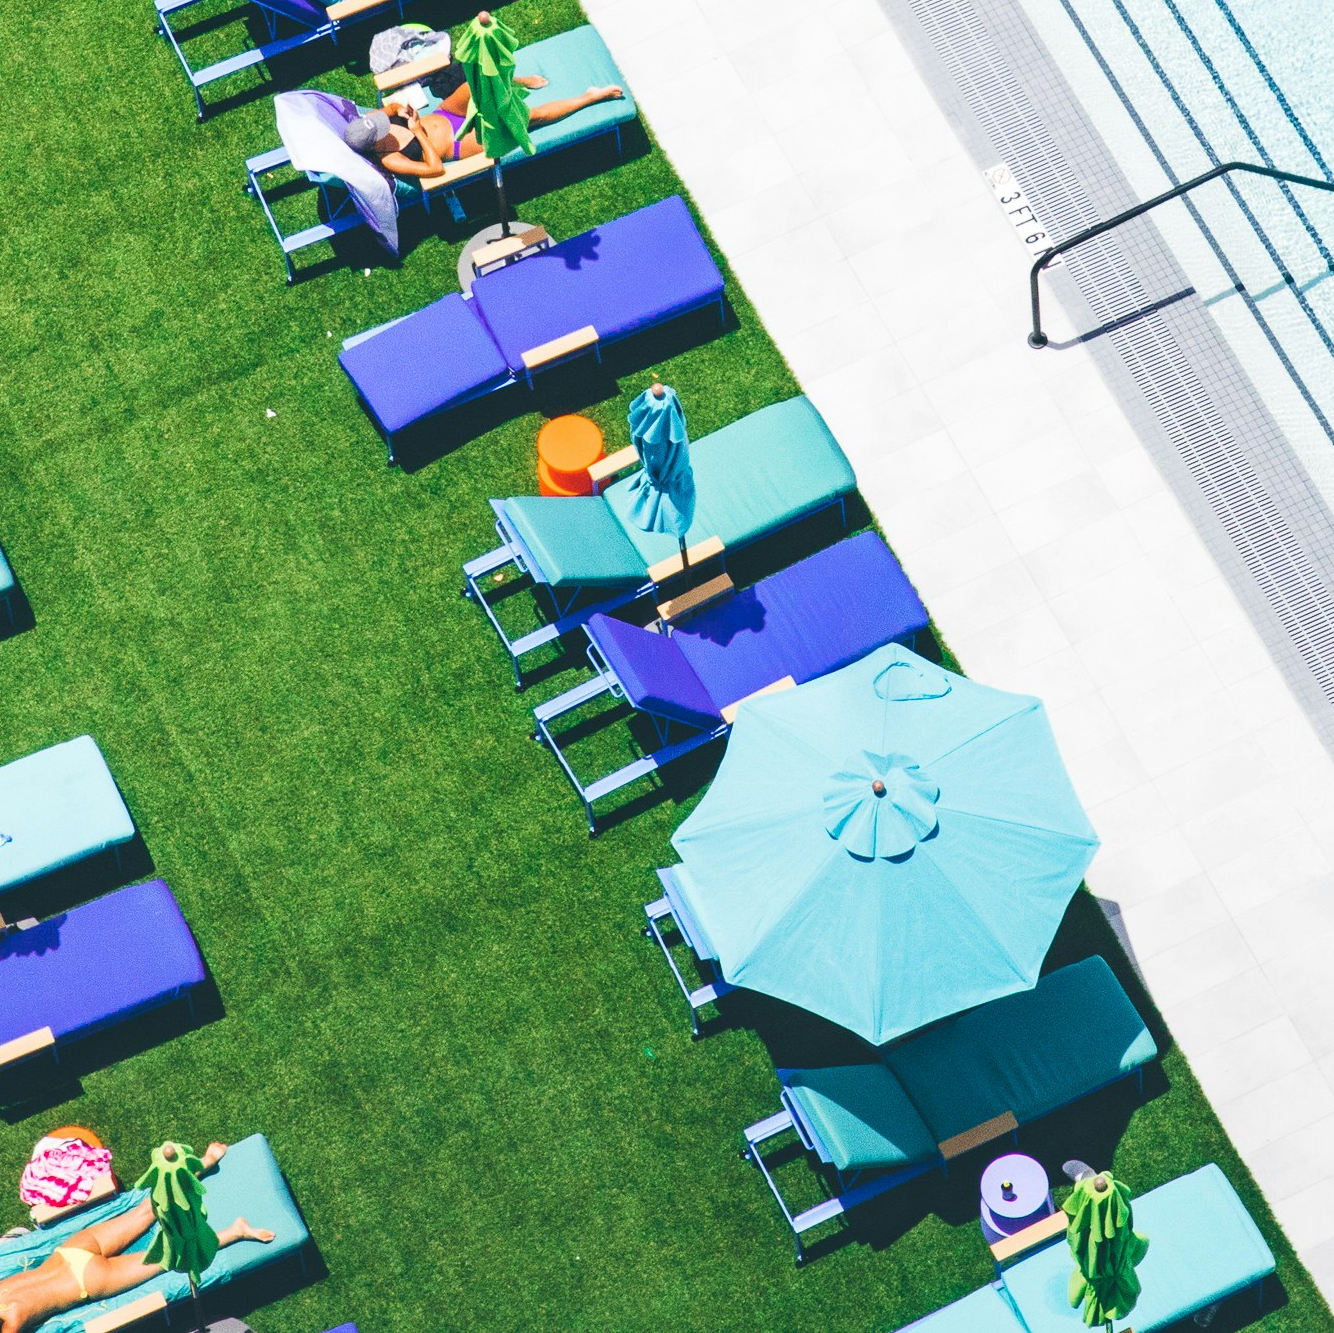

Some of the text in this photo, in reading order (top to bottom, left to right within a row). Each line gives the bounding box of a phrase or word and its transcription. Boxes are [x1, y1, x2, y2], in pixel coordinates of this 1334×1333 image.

[1000, 191, 1021, 204] 3
[1008, 205, 1038, 228] FT
[1025, 232, 1046, 244] 6
